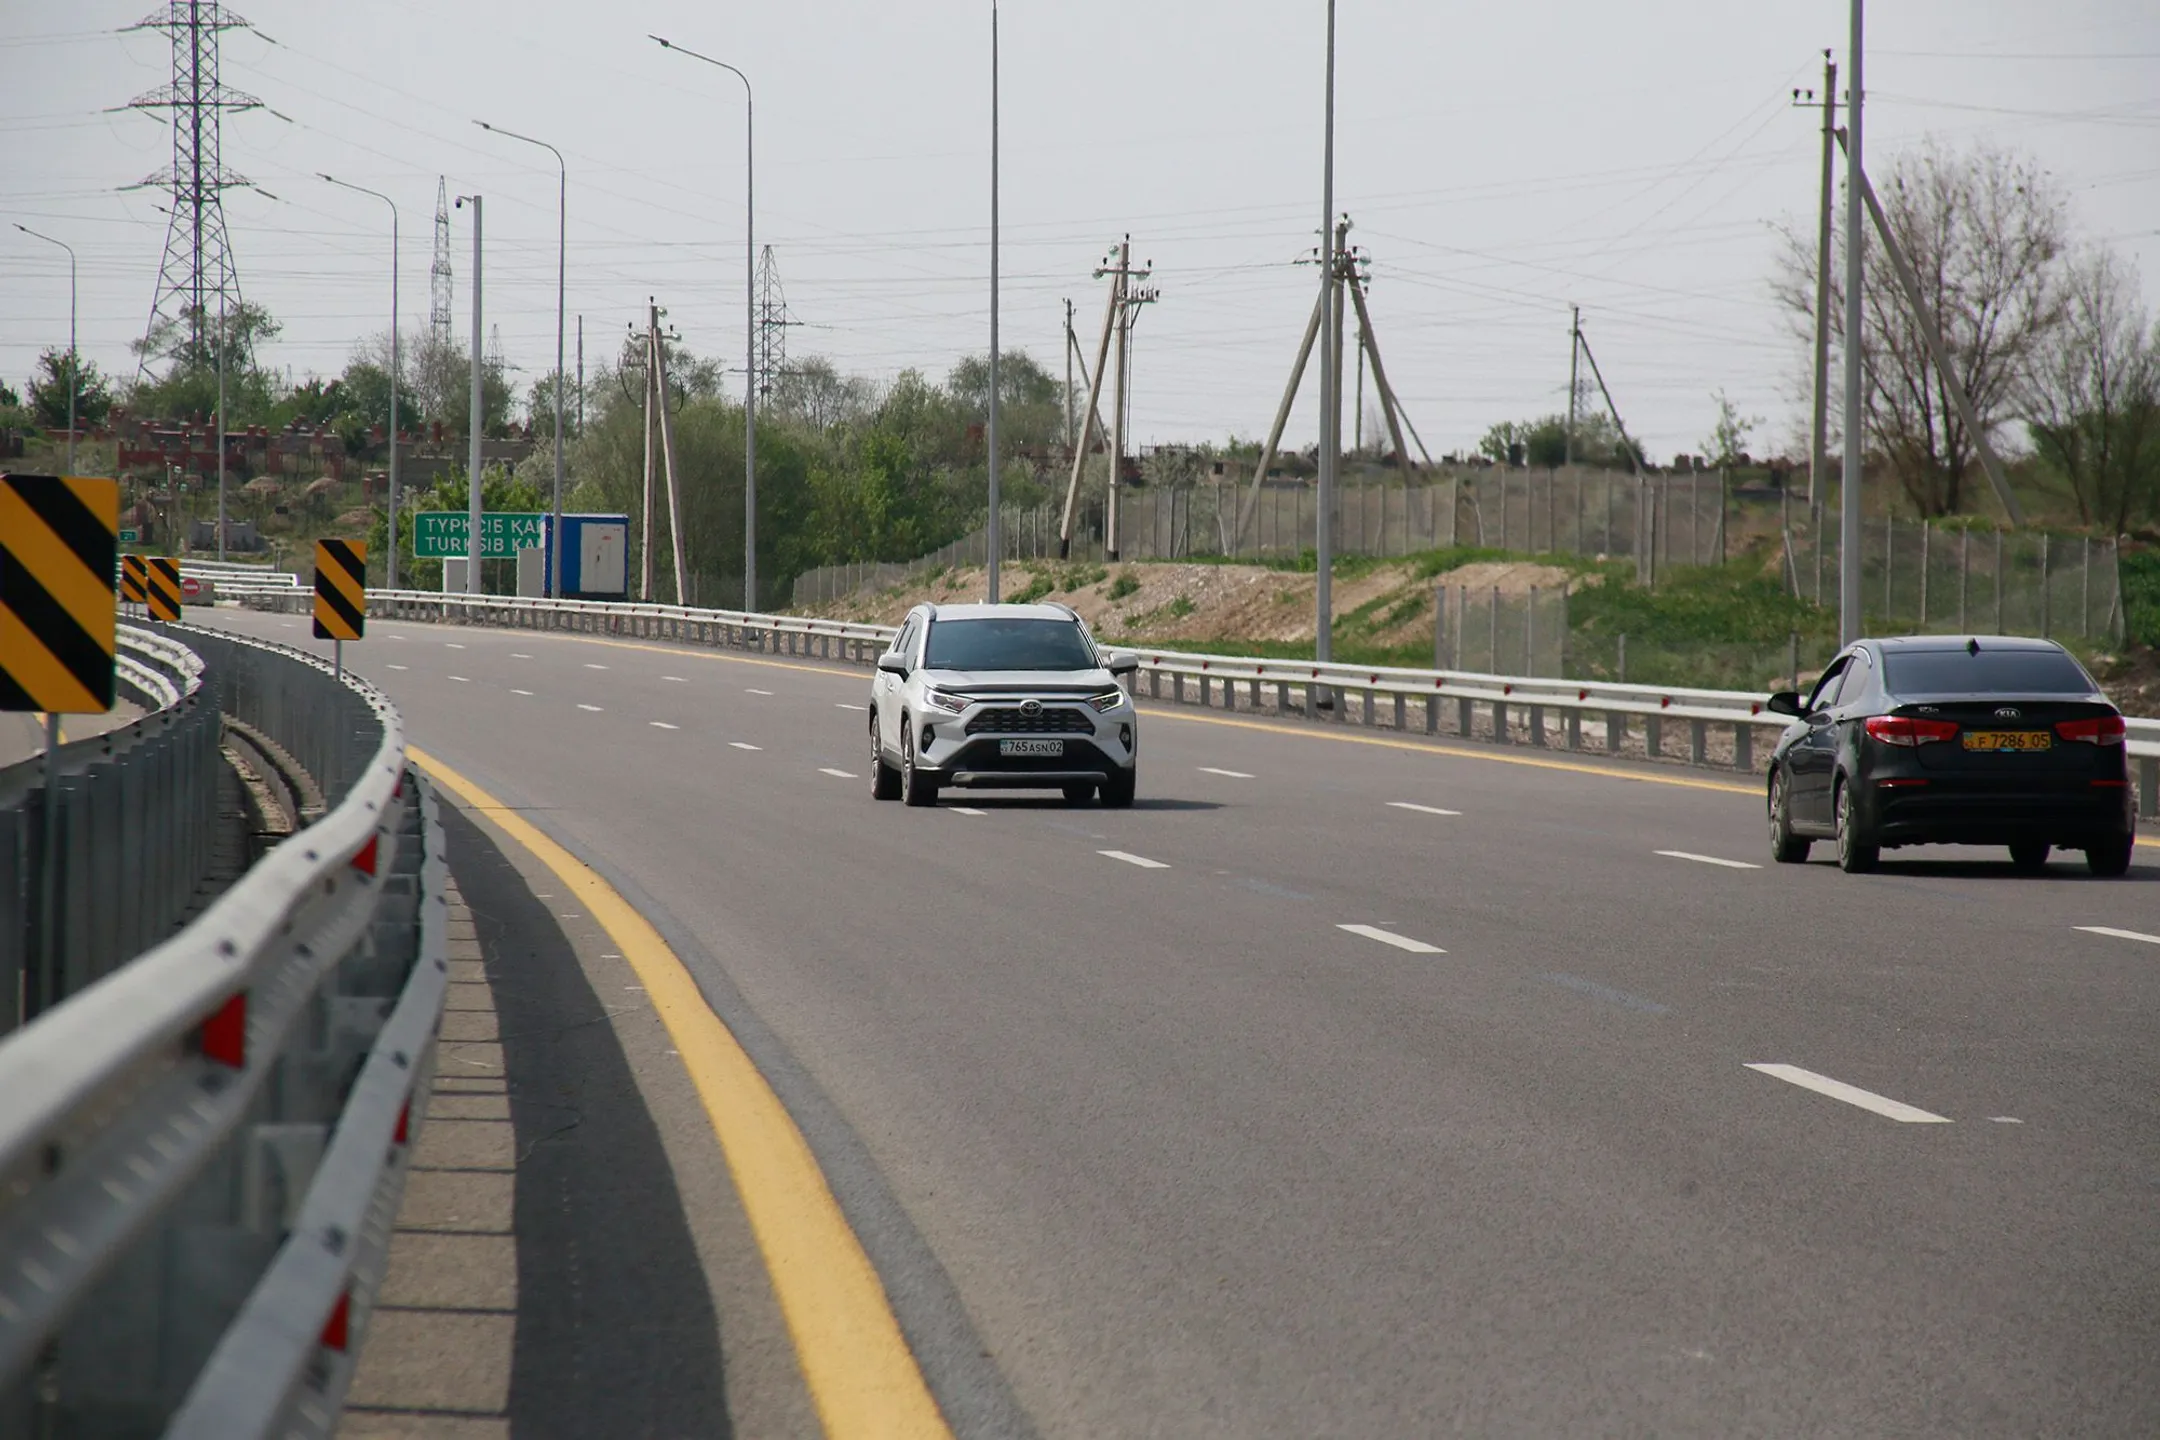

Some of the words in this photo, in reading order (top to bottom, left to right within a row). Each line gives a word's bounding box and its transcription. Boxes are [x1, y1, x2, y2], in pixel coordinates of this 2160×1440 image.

[2000, 710, 2017, 718] KIA
[1990, 734, 2025, 748] 7286
[2031, 734, 2049, 748] 05
